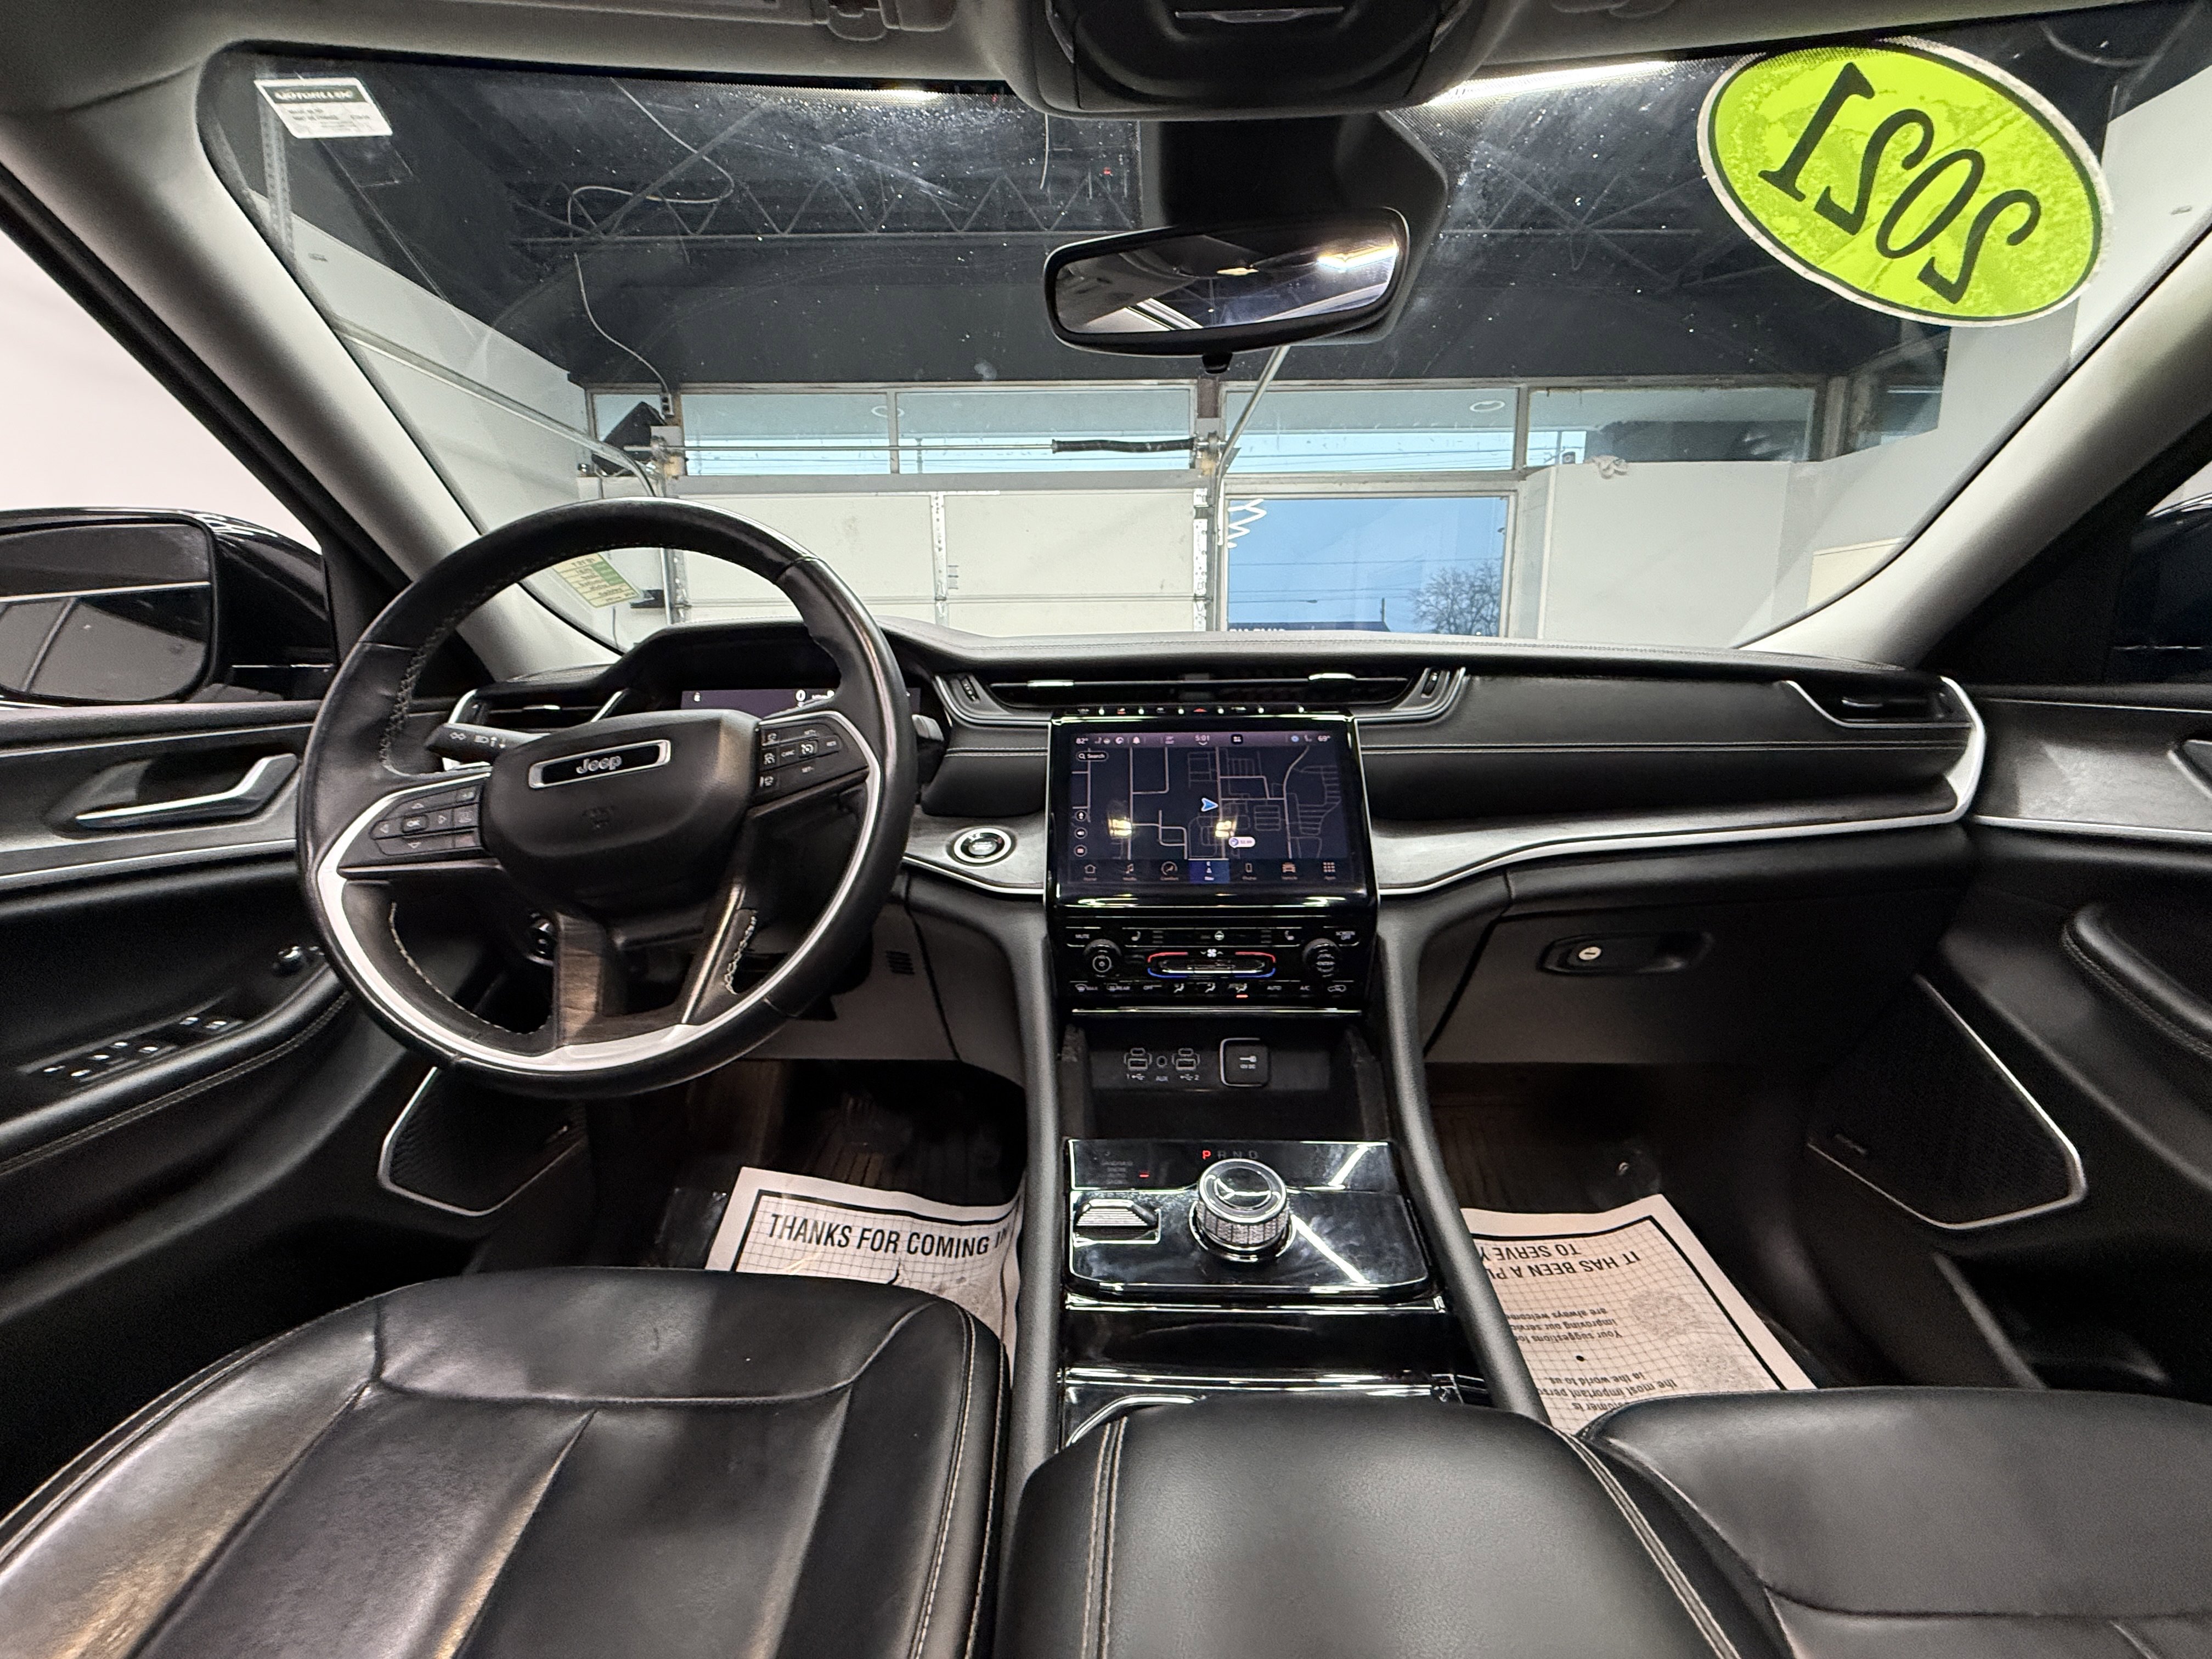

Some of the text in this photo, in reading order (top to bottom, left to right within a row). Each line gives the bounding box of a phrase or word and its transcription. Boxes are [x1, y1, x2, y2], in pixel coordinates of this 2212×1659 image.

[575, 756, 622, 774] Jeep
[1202, 1150, 1211, 1160] P
[1233, 1150, 1242, 1159] N
[1249, 1150, 1259, 1159] D
[768, 1214, 852, 1248] THANKS
[856, 1227, 900, 1254] FOR
[906, 1232, 990, 1259] COMING
[1492, 1245, 1551, 1261] SERVE
[1555, 1243, 1581, 1256] TO
[1622, 1251, 1641, 1265] IT
[1527, 1262, 1577, 1277] BEEN
[1579, 1256, 1620, 1272] HAS
[1510, 1266, 1523, 1278] A
[1551, 1308, 1589, 1318] always
[1590, 1307, 1609, 1316] are
[1546, 1322, 1562, 1330] our
[1563, 1318, 1617, 1329] improving
[1532, 1331, 1595, 1342] suggestions
[1596, 1330, 1623, 1339] Your
[1564, 1377, 1578, 1386] to
[1578, 1376, 1610, 1386] world
[1611, 1374, 1631, 1384] the
[1632, 1372, 1646, 1380] in
[1658, 1379, 1678, 1387] the
[1570, 1387, 1624, 1398] important
[1626, 1383, 1656, 1396] most
[1571, 1402, 1584, 1412] is
